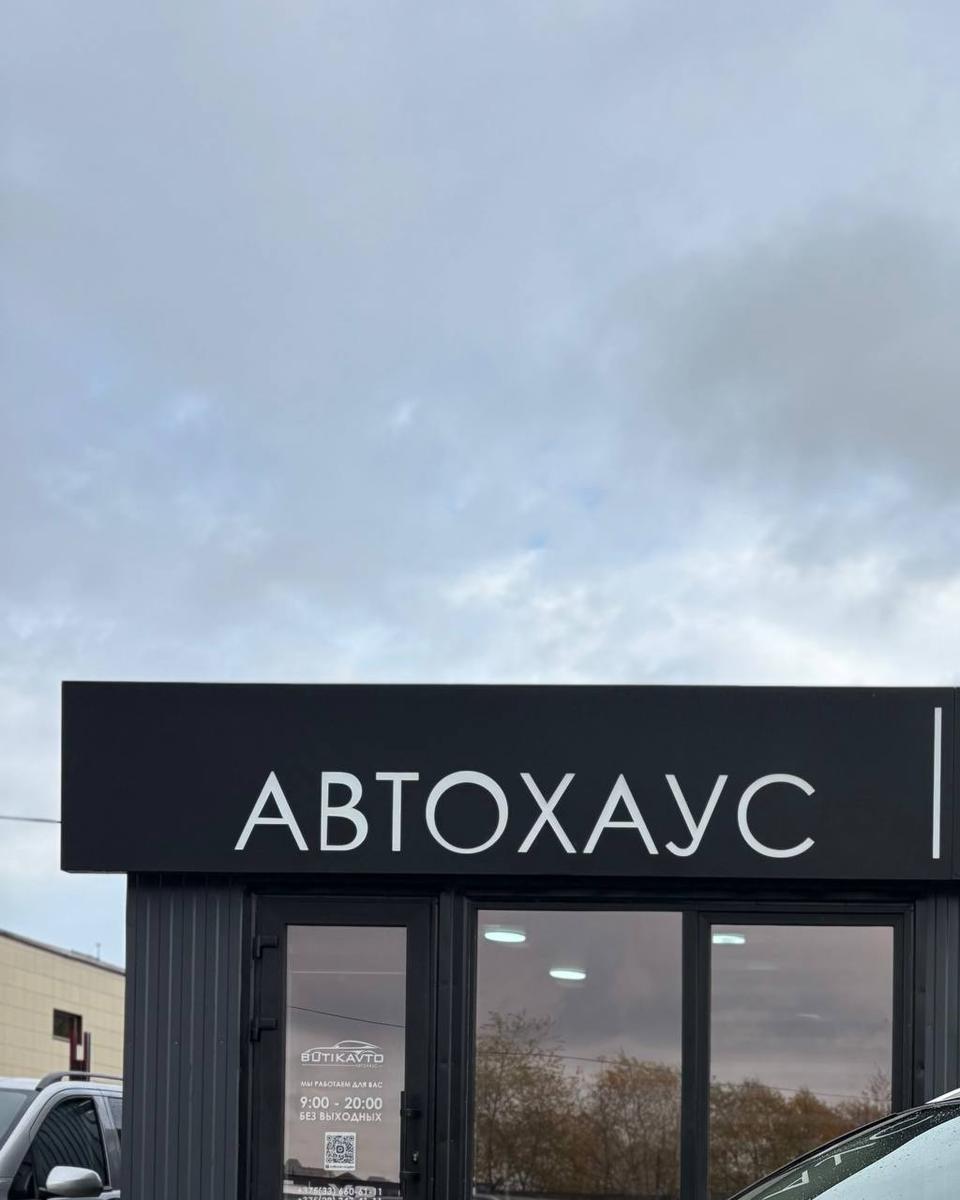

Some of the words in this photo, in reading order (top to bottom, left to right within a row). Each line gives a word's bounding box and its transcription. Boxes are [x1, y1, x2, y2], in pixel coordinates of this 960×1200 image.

[234, 770, 815, 858] АВТОХАУС
[301, 1052, 384, 1063] BUTIKAVTO
[300, 1096, 329, 1109] 9:00
[344, 1096, 383, 1110] 20:00
[299, 1111, 317, 1121] БЕЗ
[319, 1111, 382, 1122] ВЫХОДНЫХ
